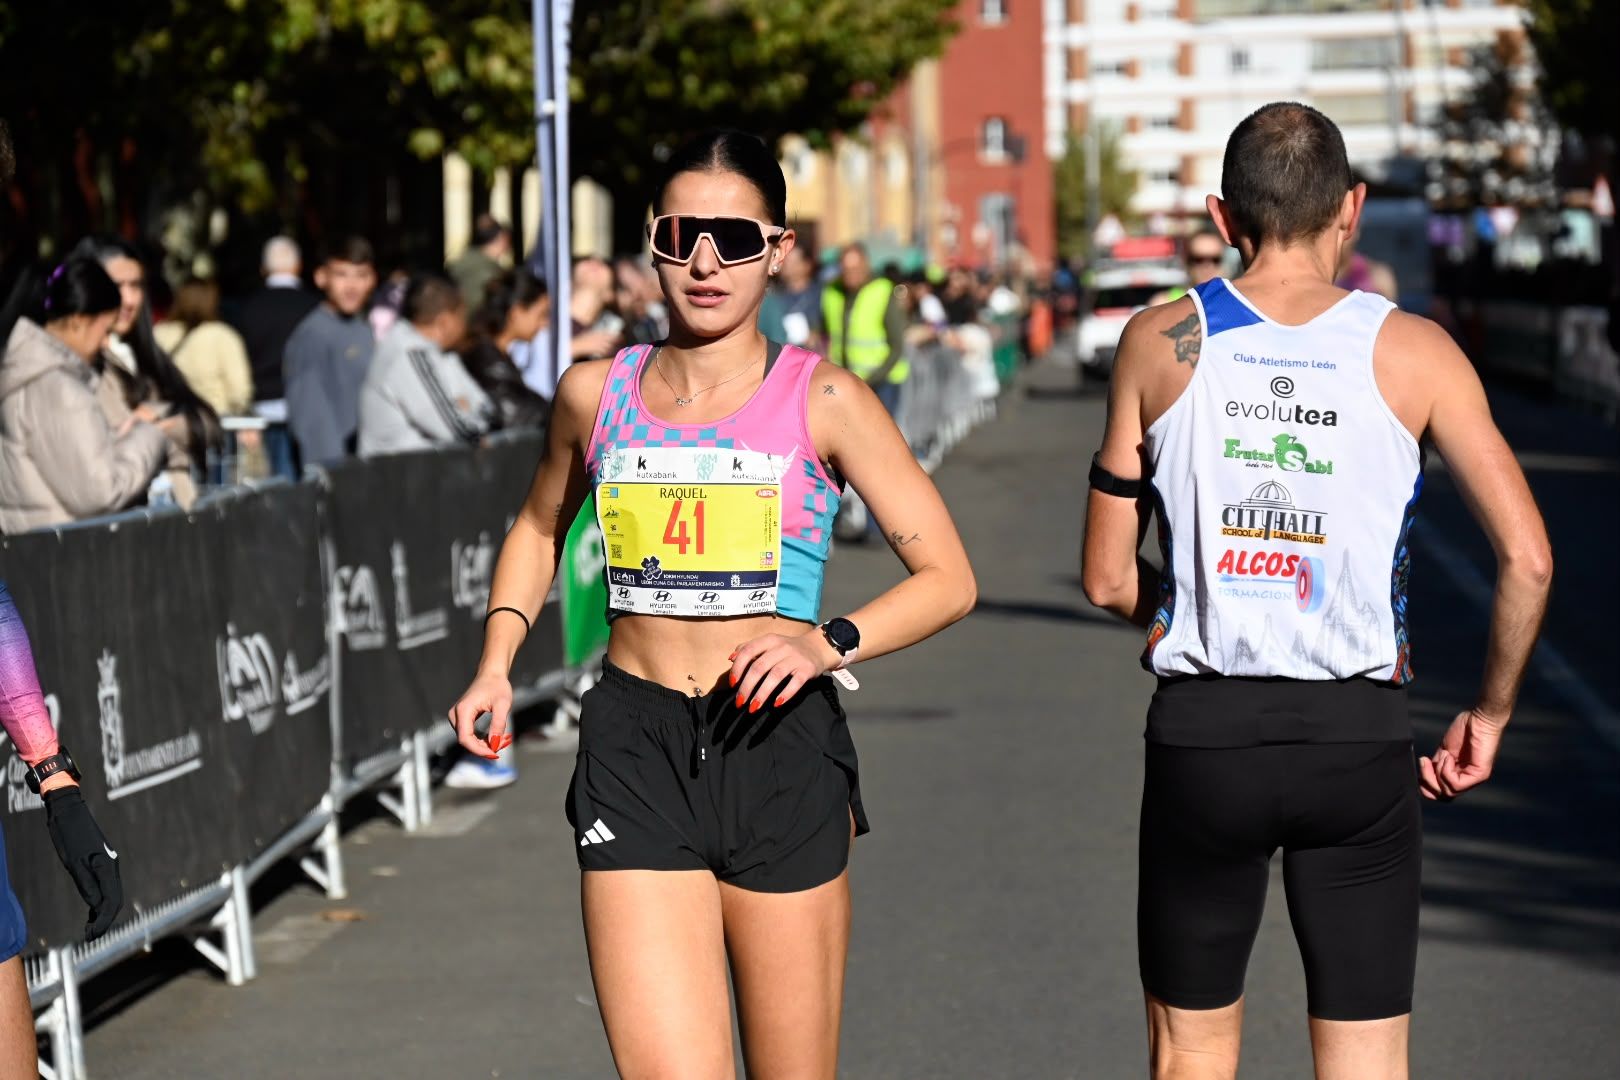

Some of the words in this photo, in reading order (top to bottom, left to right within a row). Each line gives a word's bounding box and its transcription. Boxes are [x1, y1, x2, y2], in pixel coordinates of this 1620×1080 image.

[1233, 353, 1256, 364] Club
[1259, 356, 1308, 368] Atletismo
[1311, 359, 1337, 370] León
[1225, 400, 1337, 427] evolutea
[1224, 438, 1274, 462] Frutas
[1283, 450, 1333, 475] Sabi
[660, 487, 707, 500] RAQUEL
[662, 500, 705, 554] 41
[1222, 527, 1254, 538] SCHOOL
[1273, 530, 1325, 544] LANGUAGES
[1217, 549, 1300, 577] ALCOS
